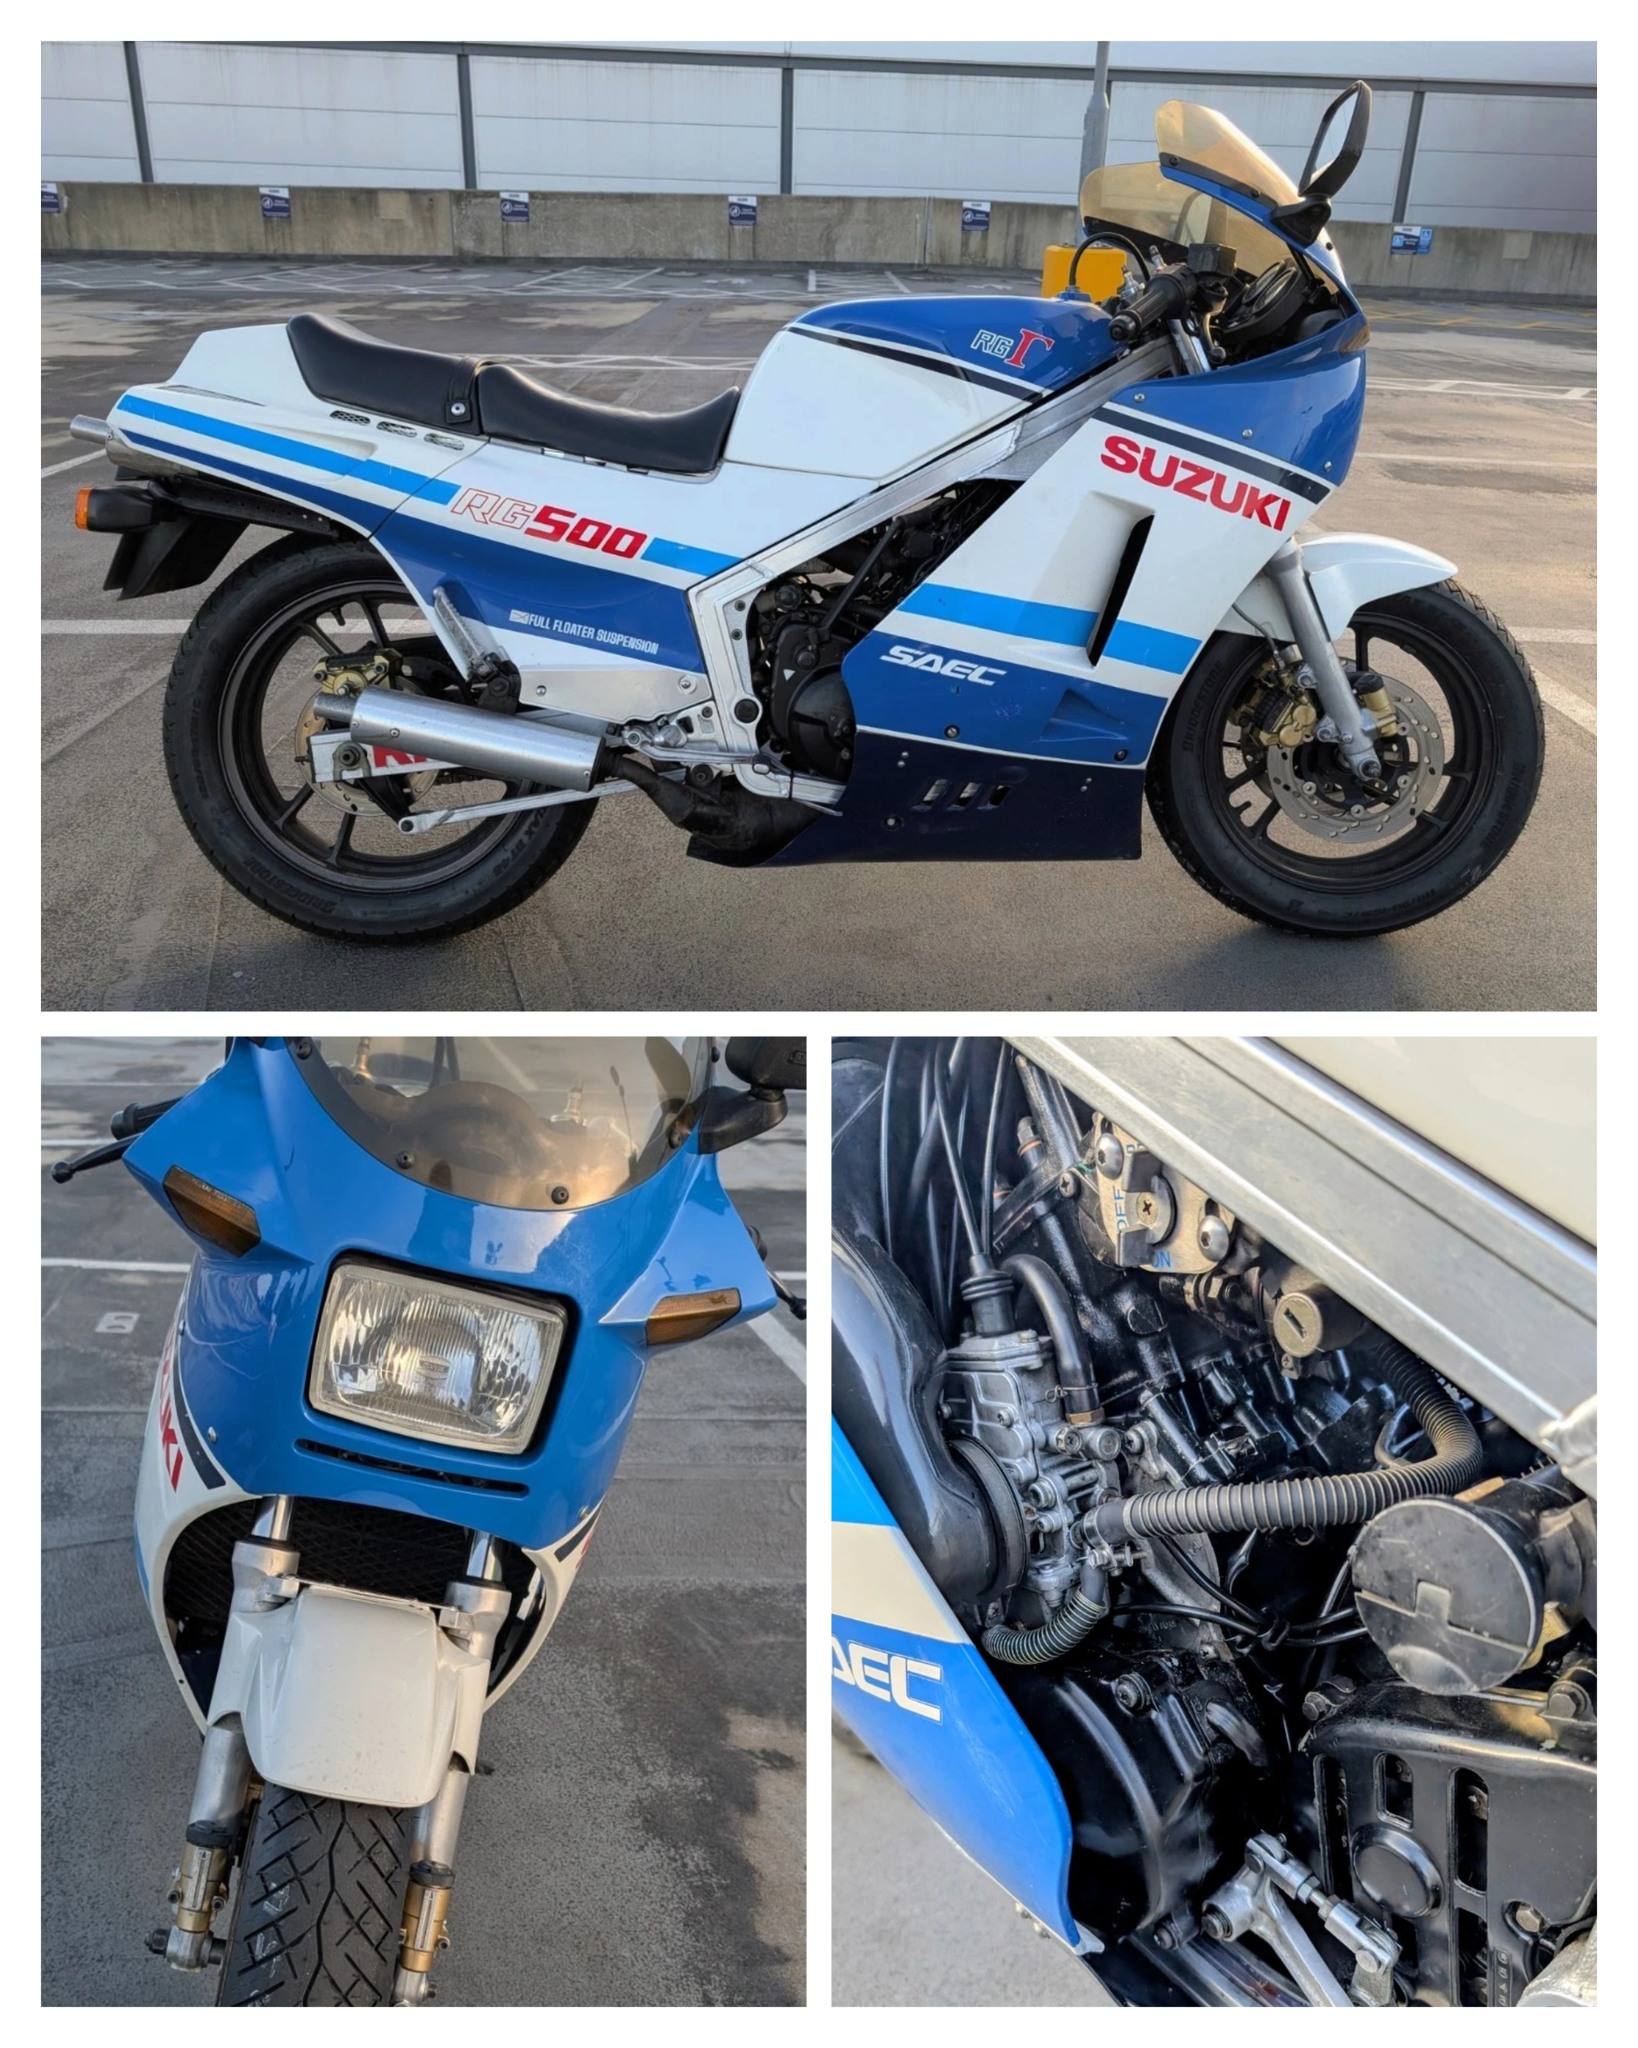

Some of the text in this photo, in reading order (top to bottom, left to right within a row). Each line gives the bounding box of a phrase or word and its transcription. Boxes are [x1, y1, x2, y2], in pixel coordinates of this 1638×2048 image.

[1100, 436, 1291, 531] SUZUKI
[451, 488, 648, 559] RG500
[528, 614, 659, 654] FULL FLOATER SUSPENSION
[880, 645, 1007, 686] SAEC
[1183, 660, 1224, 752] BRIDGESTONE
[243, 856, 338, 914] BRIDGESTONE
